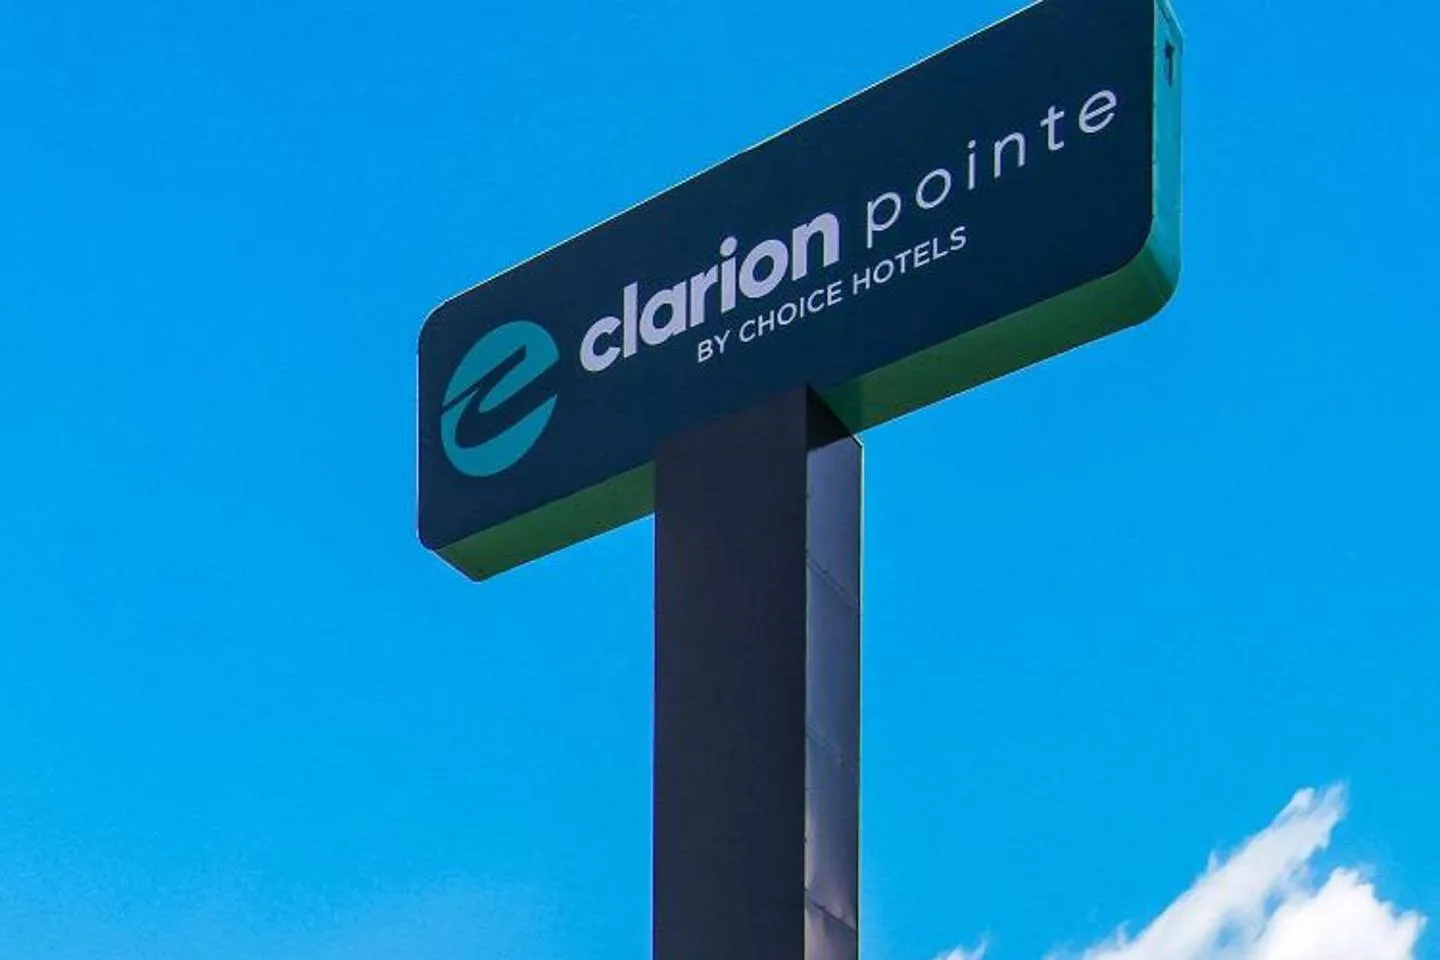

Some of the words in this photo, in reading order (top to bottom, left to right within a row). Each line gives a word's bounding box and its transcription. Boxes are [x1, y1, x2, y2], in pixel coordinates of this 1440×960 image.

[578, 212, 841, 373] clarion
[865, 90, 1118, 250] pointe
[697, 330, 732, 364] BY
[738, 281, 843, 344] CHOICE
[852, 226, 968, 296] HOTELS
